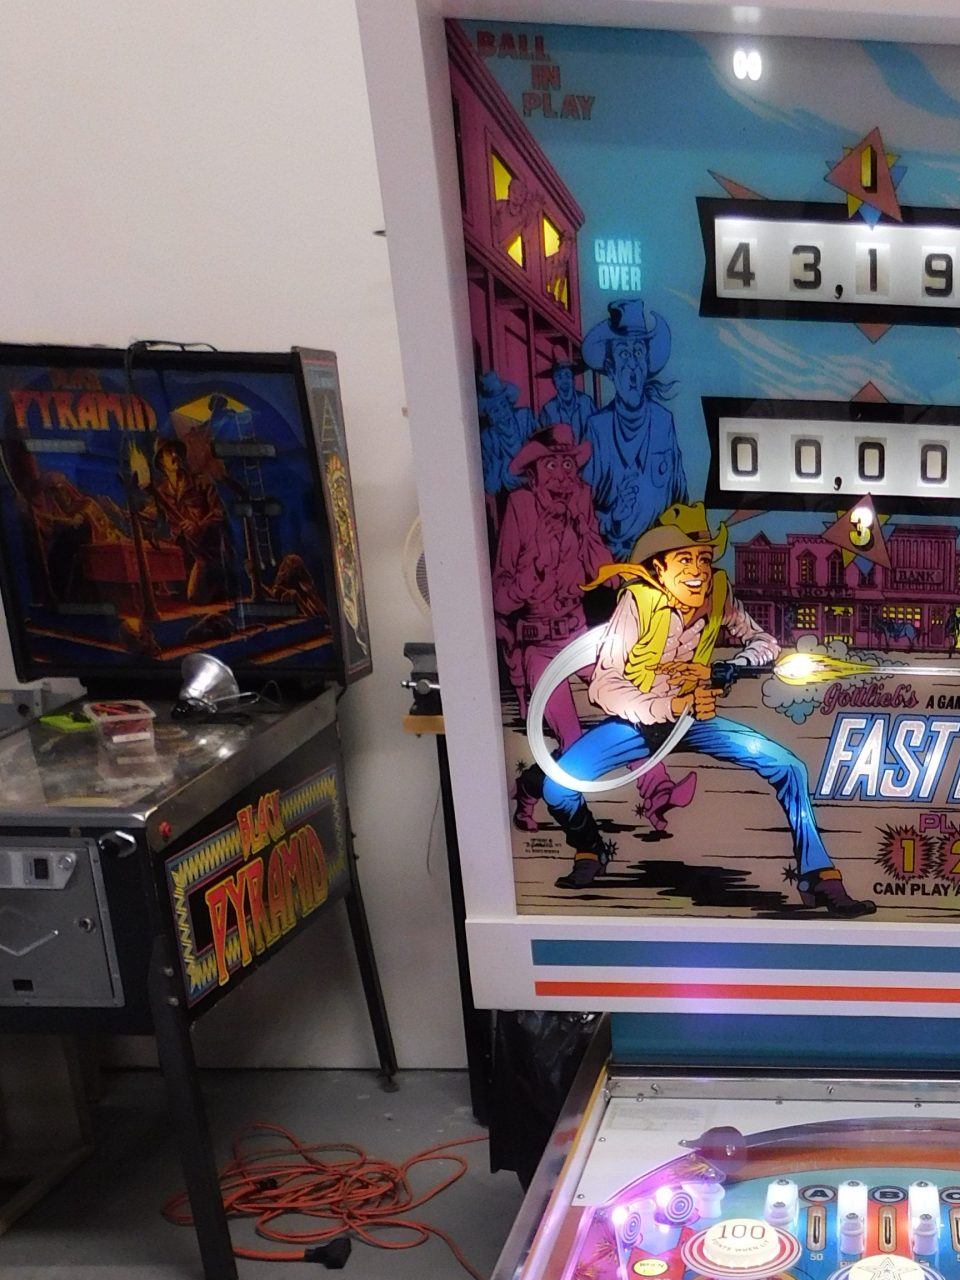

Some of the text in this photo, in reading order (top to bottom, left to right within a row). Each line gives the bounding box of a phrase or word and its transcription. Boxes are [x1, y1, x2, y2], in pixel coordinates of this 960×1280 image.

[477, 30, 550, 60] BALL
[531, 63, 561, 90] IN
[522, 92, 596, 121] PLAY
[859, 144, 878, 193] 1
[594, 239, 642, 265] GAME
[598, 264, 642, 291] OVER
[849, 506, 873, 546] 3
[899, 570, 935, 582] BANK
[820, 683, 919, 714] Gottlieb's
[925, 695, 935, 709] A
[901, 838, 916, 873] 1
[873, 882, 906, 896] CAN
[910, 883, 950, 897] PLAY
[205, 825, 329, 986] PYRAMID
[808, 1189, 829, 1199] A
[879, 1190, 901, 1200] B
[718, 1224, 766, 1240] 100
[810, 1253, 824, 1262] 50
